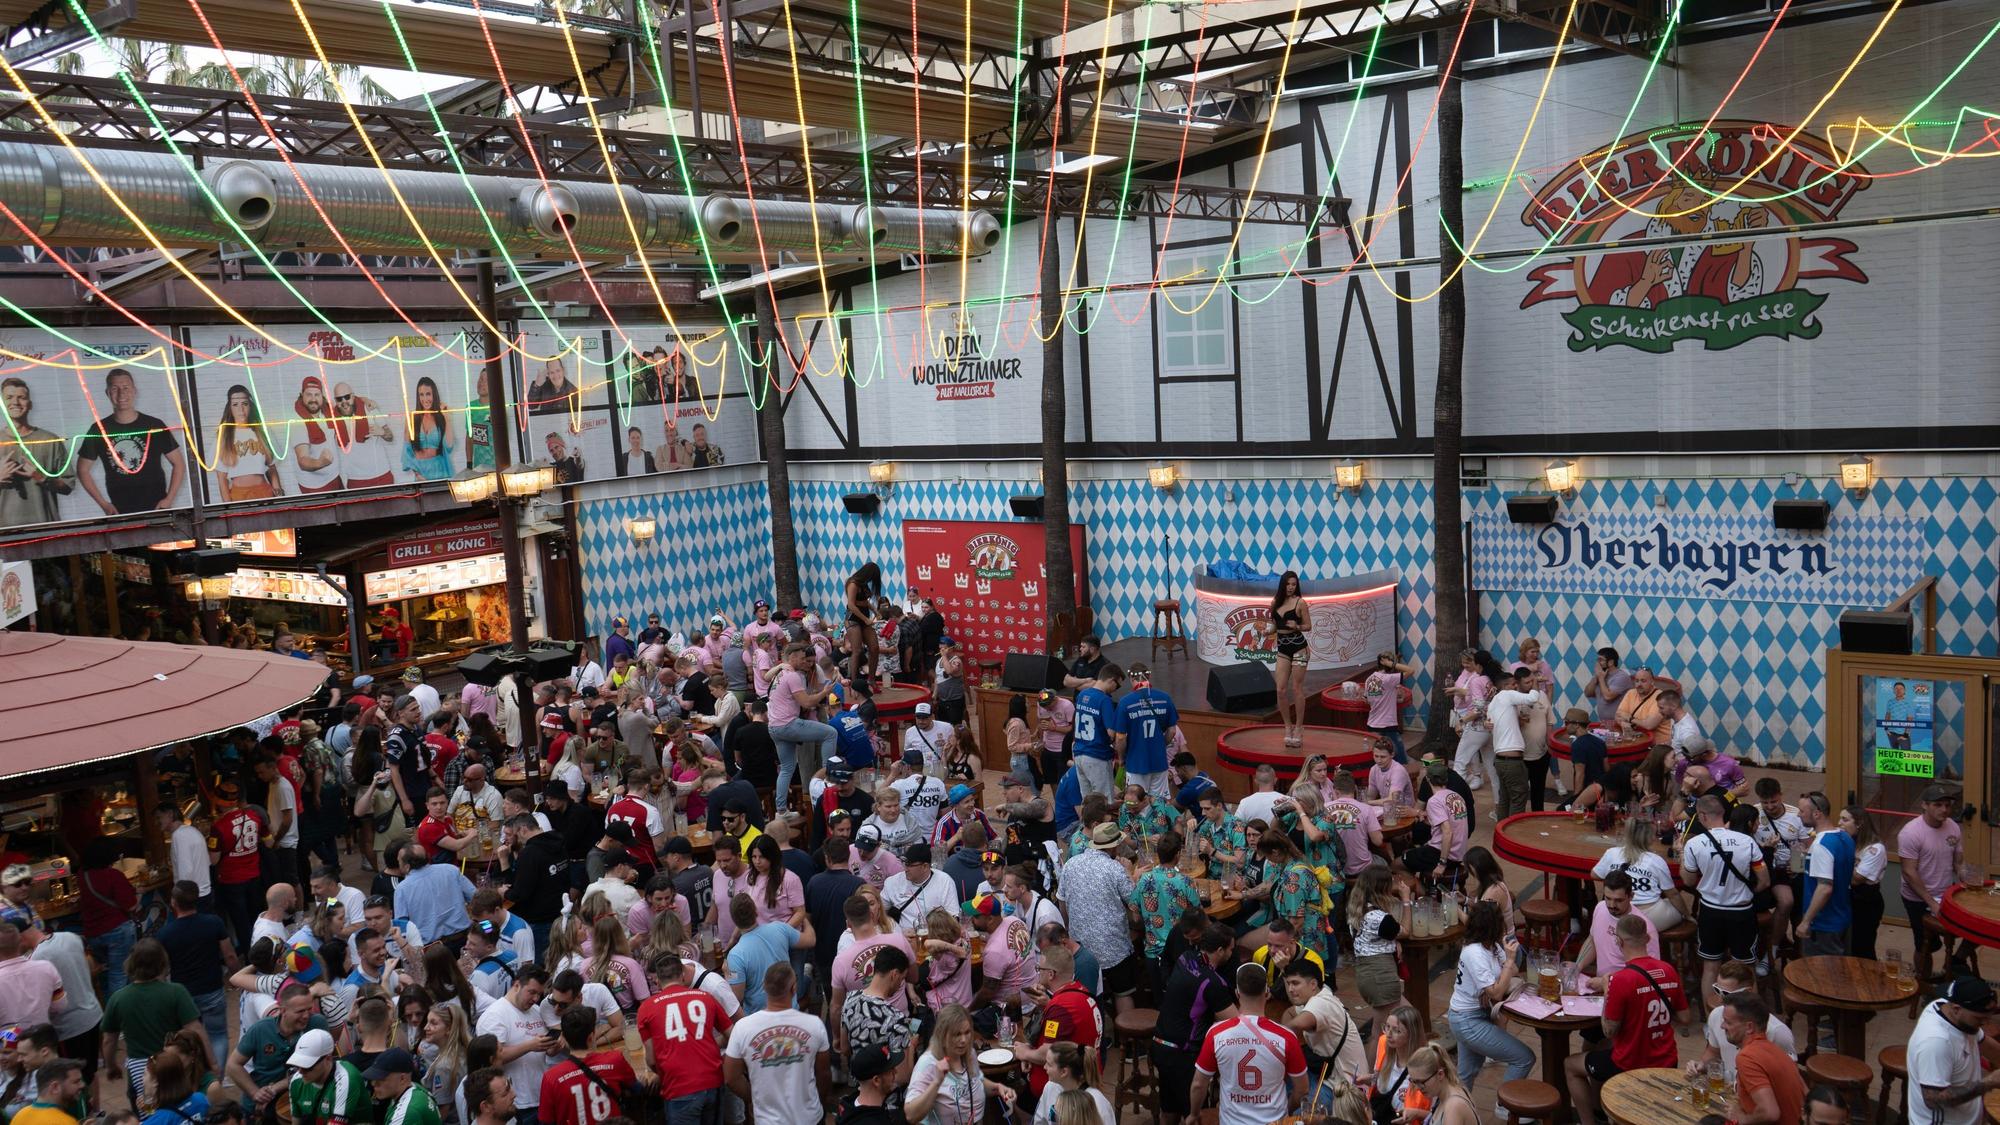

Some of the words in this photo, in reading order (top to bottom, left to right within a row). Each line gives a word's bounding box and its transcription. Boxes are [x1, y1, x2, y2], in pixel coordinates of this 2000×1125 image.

[1537, 131, 1852, 232] BIERKÖNIG
[944, 335, 981, 357] DEIN
[913, 358, 1023, 386] WOHNZIMMER
[940, 387, 953, 398] AUF
[954, 384, 990, 397] MALLORCA!
[436, 527, 463, 536] leckeren
[463, 524, 483, 533] Snack
[395, 544, 431, 558] GRILL
[447, 537, 486, 552] KÖNIG
[968, 535, 1018, 553] BIERKÖNIG
[1537, 521, 1837, 591] Oberbayern
[1074, 712, 1096, 741] 13
[1142, 719, 1156, 739] 17
[1878, 750, 1904, 759] HEUTE
[1905, 763, 1932, 774] LIVE!
[1726, 838, 1740, 847] JR.
[1710, 851, 1734, 887] 7
[694, 877, 710, 891] GÖTZE
[665, 1000, 707, 1042] 49
[1647, 998, 1671, 1029] 25
[1226, 1037, 1250, 1046] BAYERN
[1238, 1049, 1263, 1091] 6
[571, 1079, 611, 1125] 18
[1230, 1092, 1272, 1104] KIMMICH
